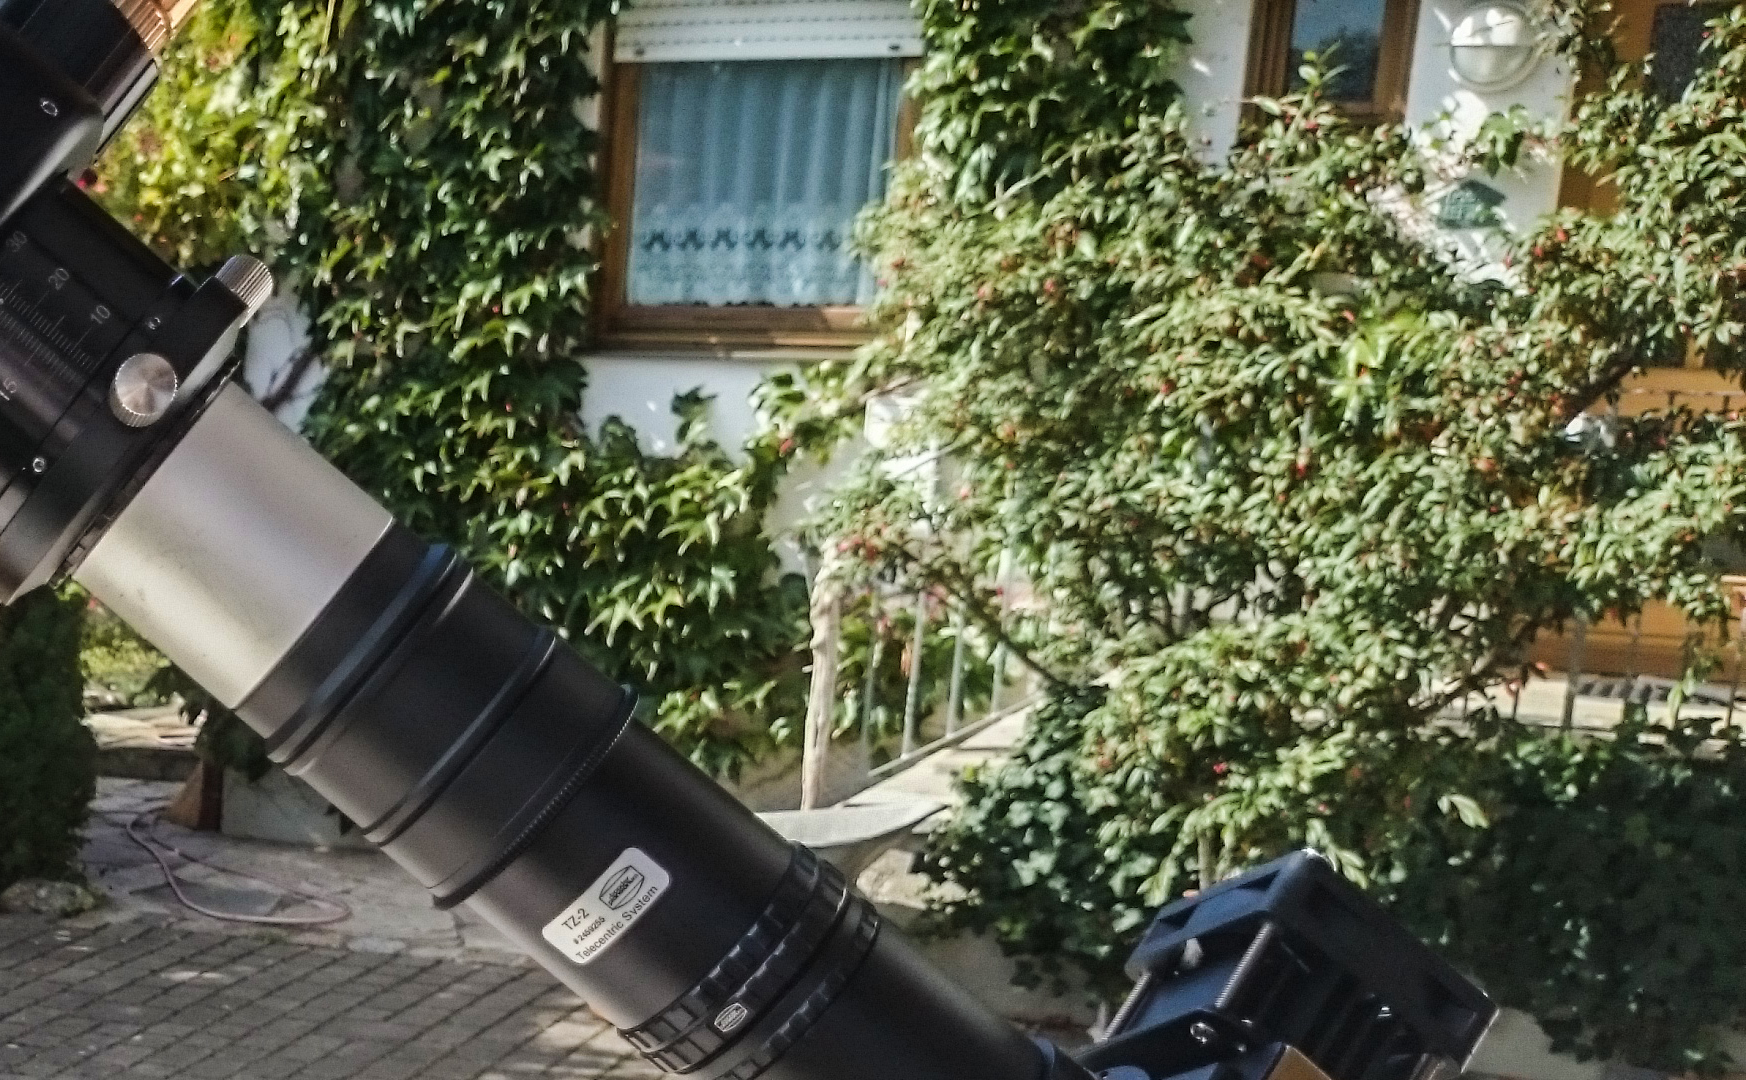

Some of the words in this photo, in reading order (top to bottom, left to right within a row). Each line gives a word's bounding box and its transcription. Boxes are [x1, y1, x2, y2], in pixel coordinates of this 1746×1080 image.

[48, 267, 70, 290] 20
[90, 305, 111, 325] 10
[561, 907, 590, 931] TZ-2
[576, 920, 624, 960] Telecentric
[622, 885, 658, 921] System
